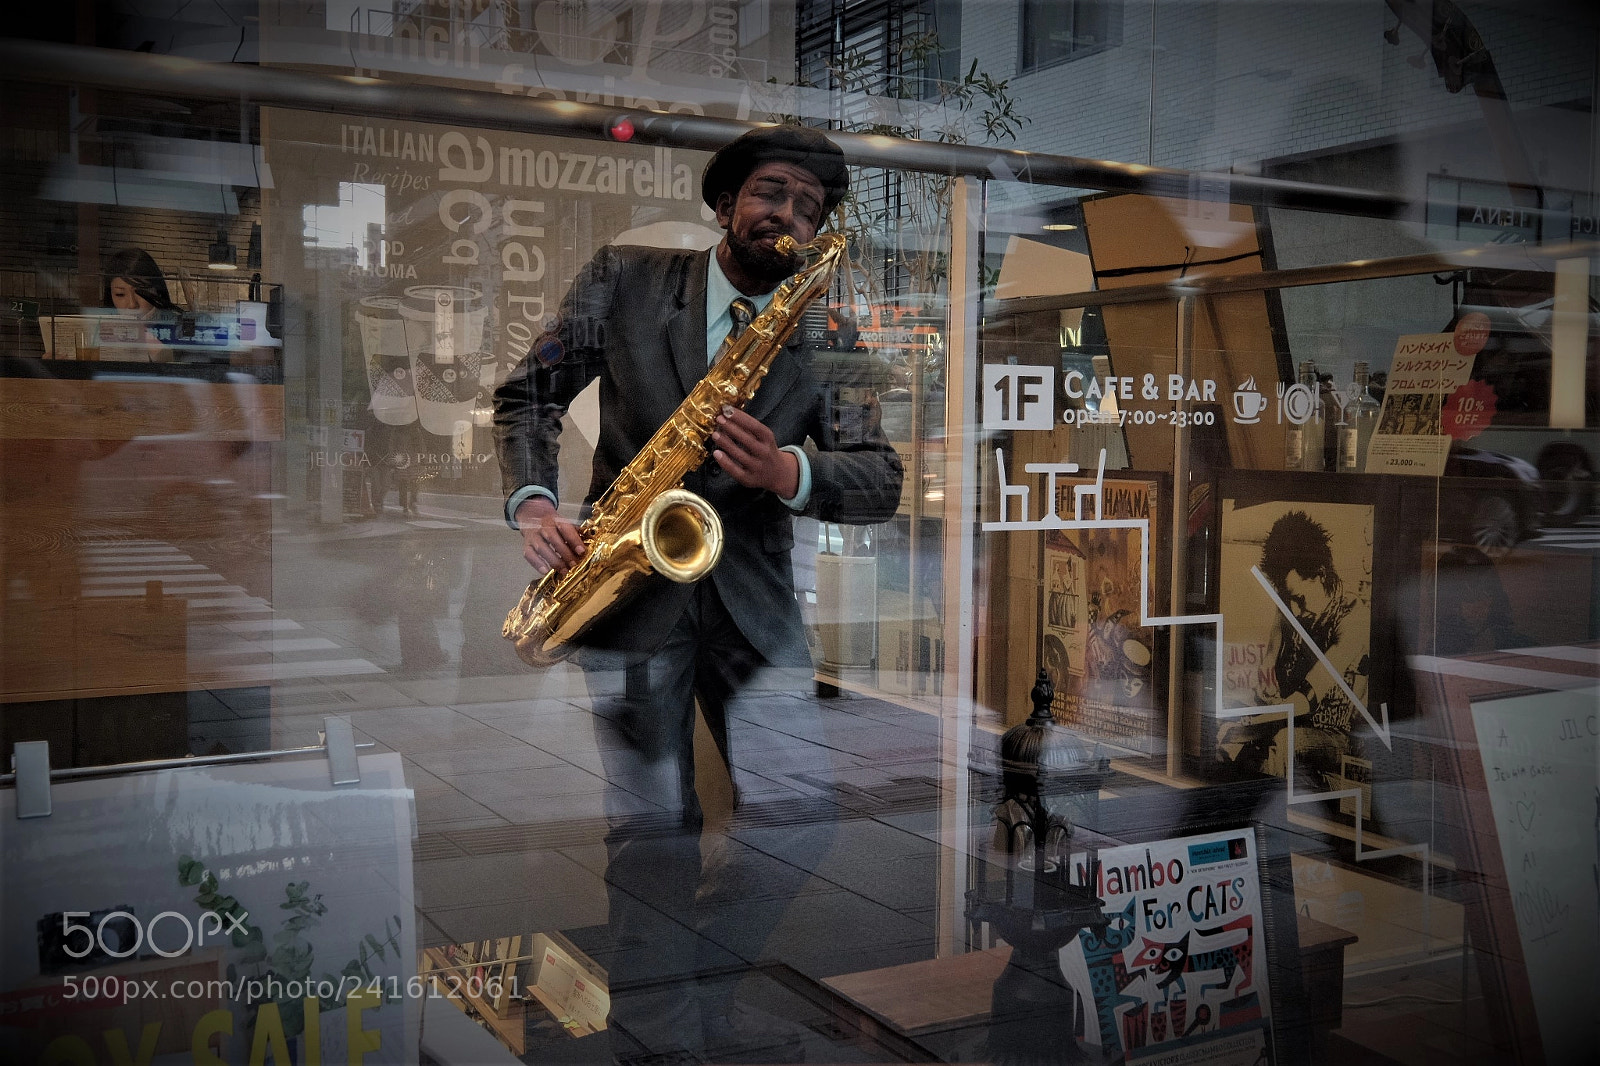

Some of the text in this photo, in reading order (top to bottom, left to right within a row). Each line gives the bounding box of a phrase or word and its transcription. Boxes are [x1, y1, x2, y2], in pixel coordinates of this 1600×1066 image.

[341, 124, 434, 163] ITALIAN
[351, 162, 431, 191] Recipes
[500, 146, 693, 200] mozzarella
[348, 263, 418, 280] AROMA
[1399, 341, 1451, 354] ハンドメイド
[1395, 360, 1468, 372] シルクスクリーン
[1064, 370, 1217, 401] CAFE & BAR
[993, 374, 1044, 421] 1F
[1457, 397, 1484, 412] 10%
[1063, 408, 1111, 429] open
[1454, 413, 1479, 425] OFF
[310, 451, 372, 470] JEUGIA
[1228, 644, 1266, 666] JUST
[1076, 848, 1184, 897] Mambo
[1142, 877, 1245, 932] For CATS
